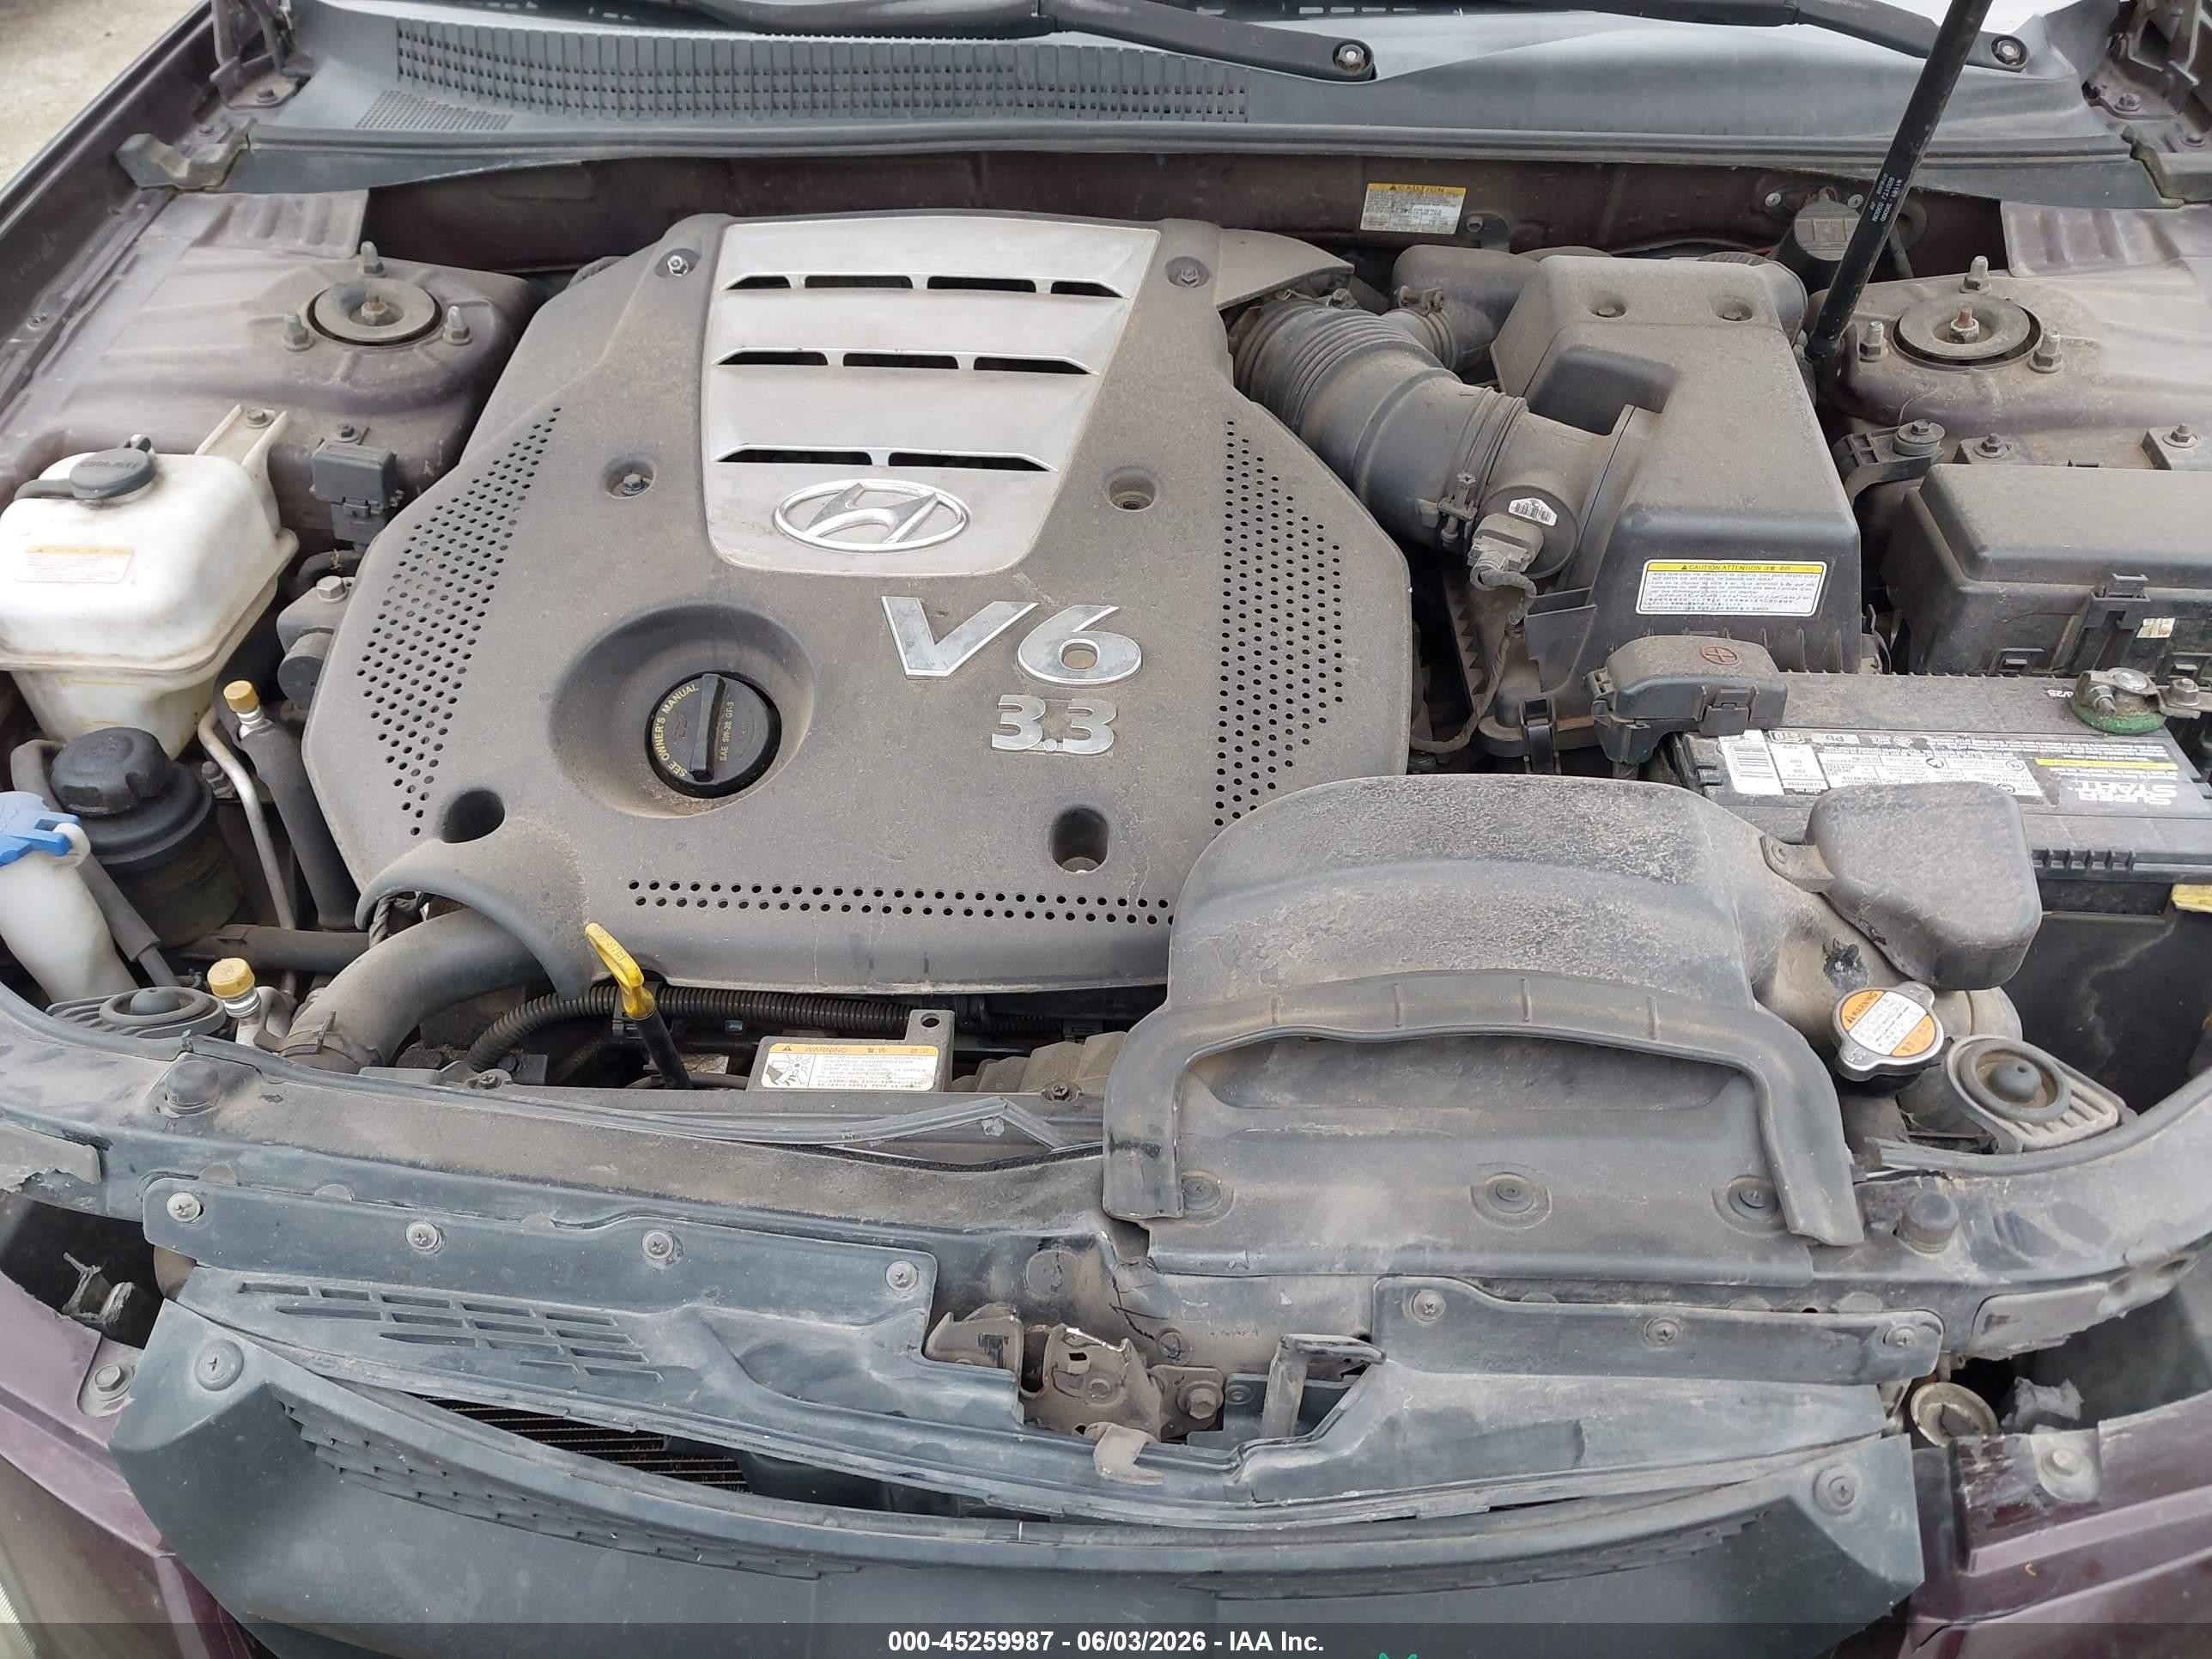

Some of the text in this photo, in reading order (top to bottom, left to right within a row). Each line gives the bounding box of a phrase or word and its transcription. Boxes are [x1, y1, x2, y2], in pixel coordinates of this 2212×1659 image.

[881, 596, 1142, 687] V6
[654, 684, 700, 777] SEE OWNER'S MANUAL
[722, 720, 732, 743] 5W-20
[991, 694, 1118, 755] 3.3
[720, 745, 729, 762] SAE
[2075, 780, 2178, 798] START
[2078, 790, 2172, 805] SUPER
